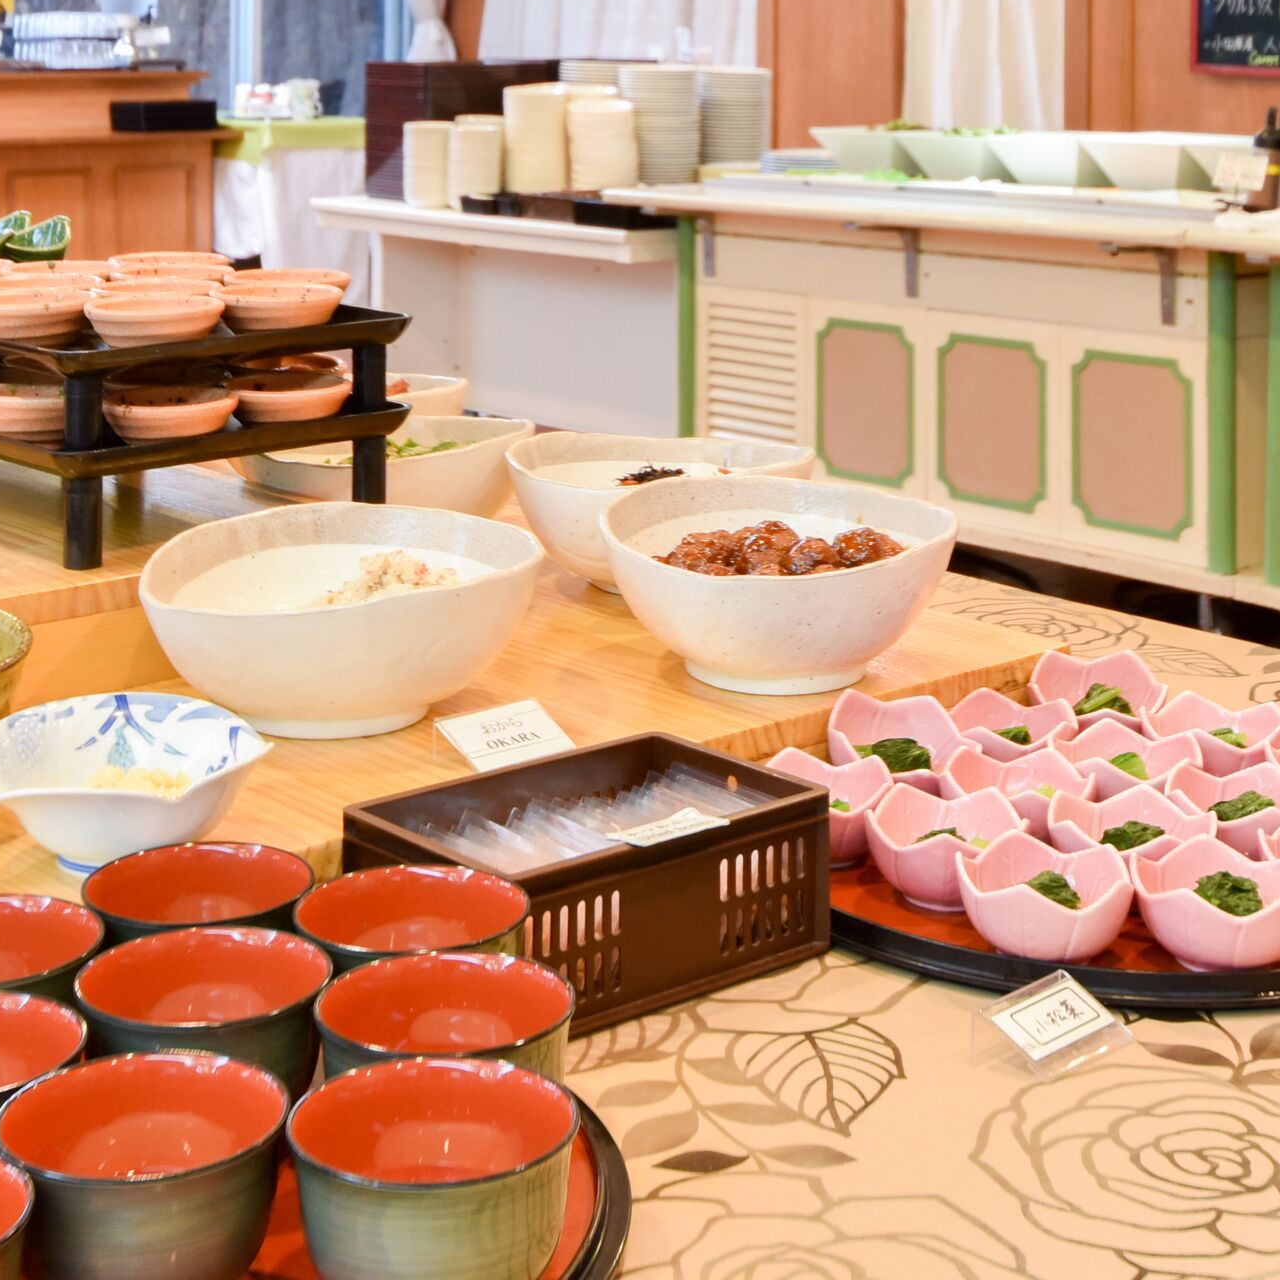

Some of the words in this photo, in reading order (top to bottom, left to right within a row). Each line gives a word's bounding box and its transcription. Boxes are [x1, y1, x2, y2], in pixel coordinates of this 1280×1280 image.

[481, 717, 524, 735] おから
[486, 731, 541, 750] OKARA
